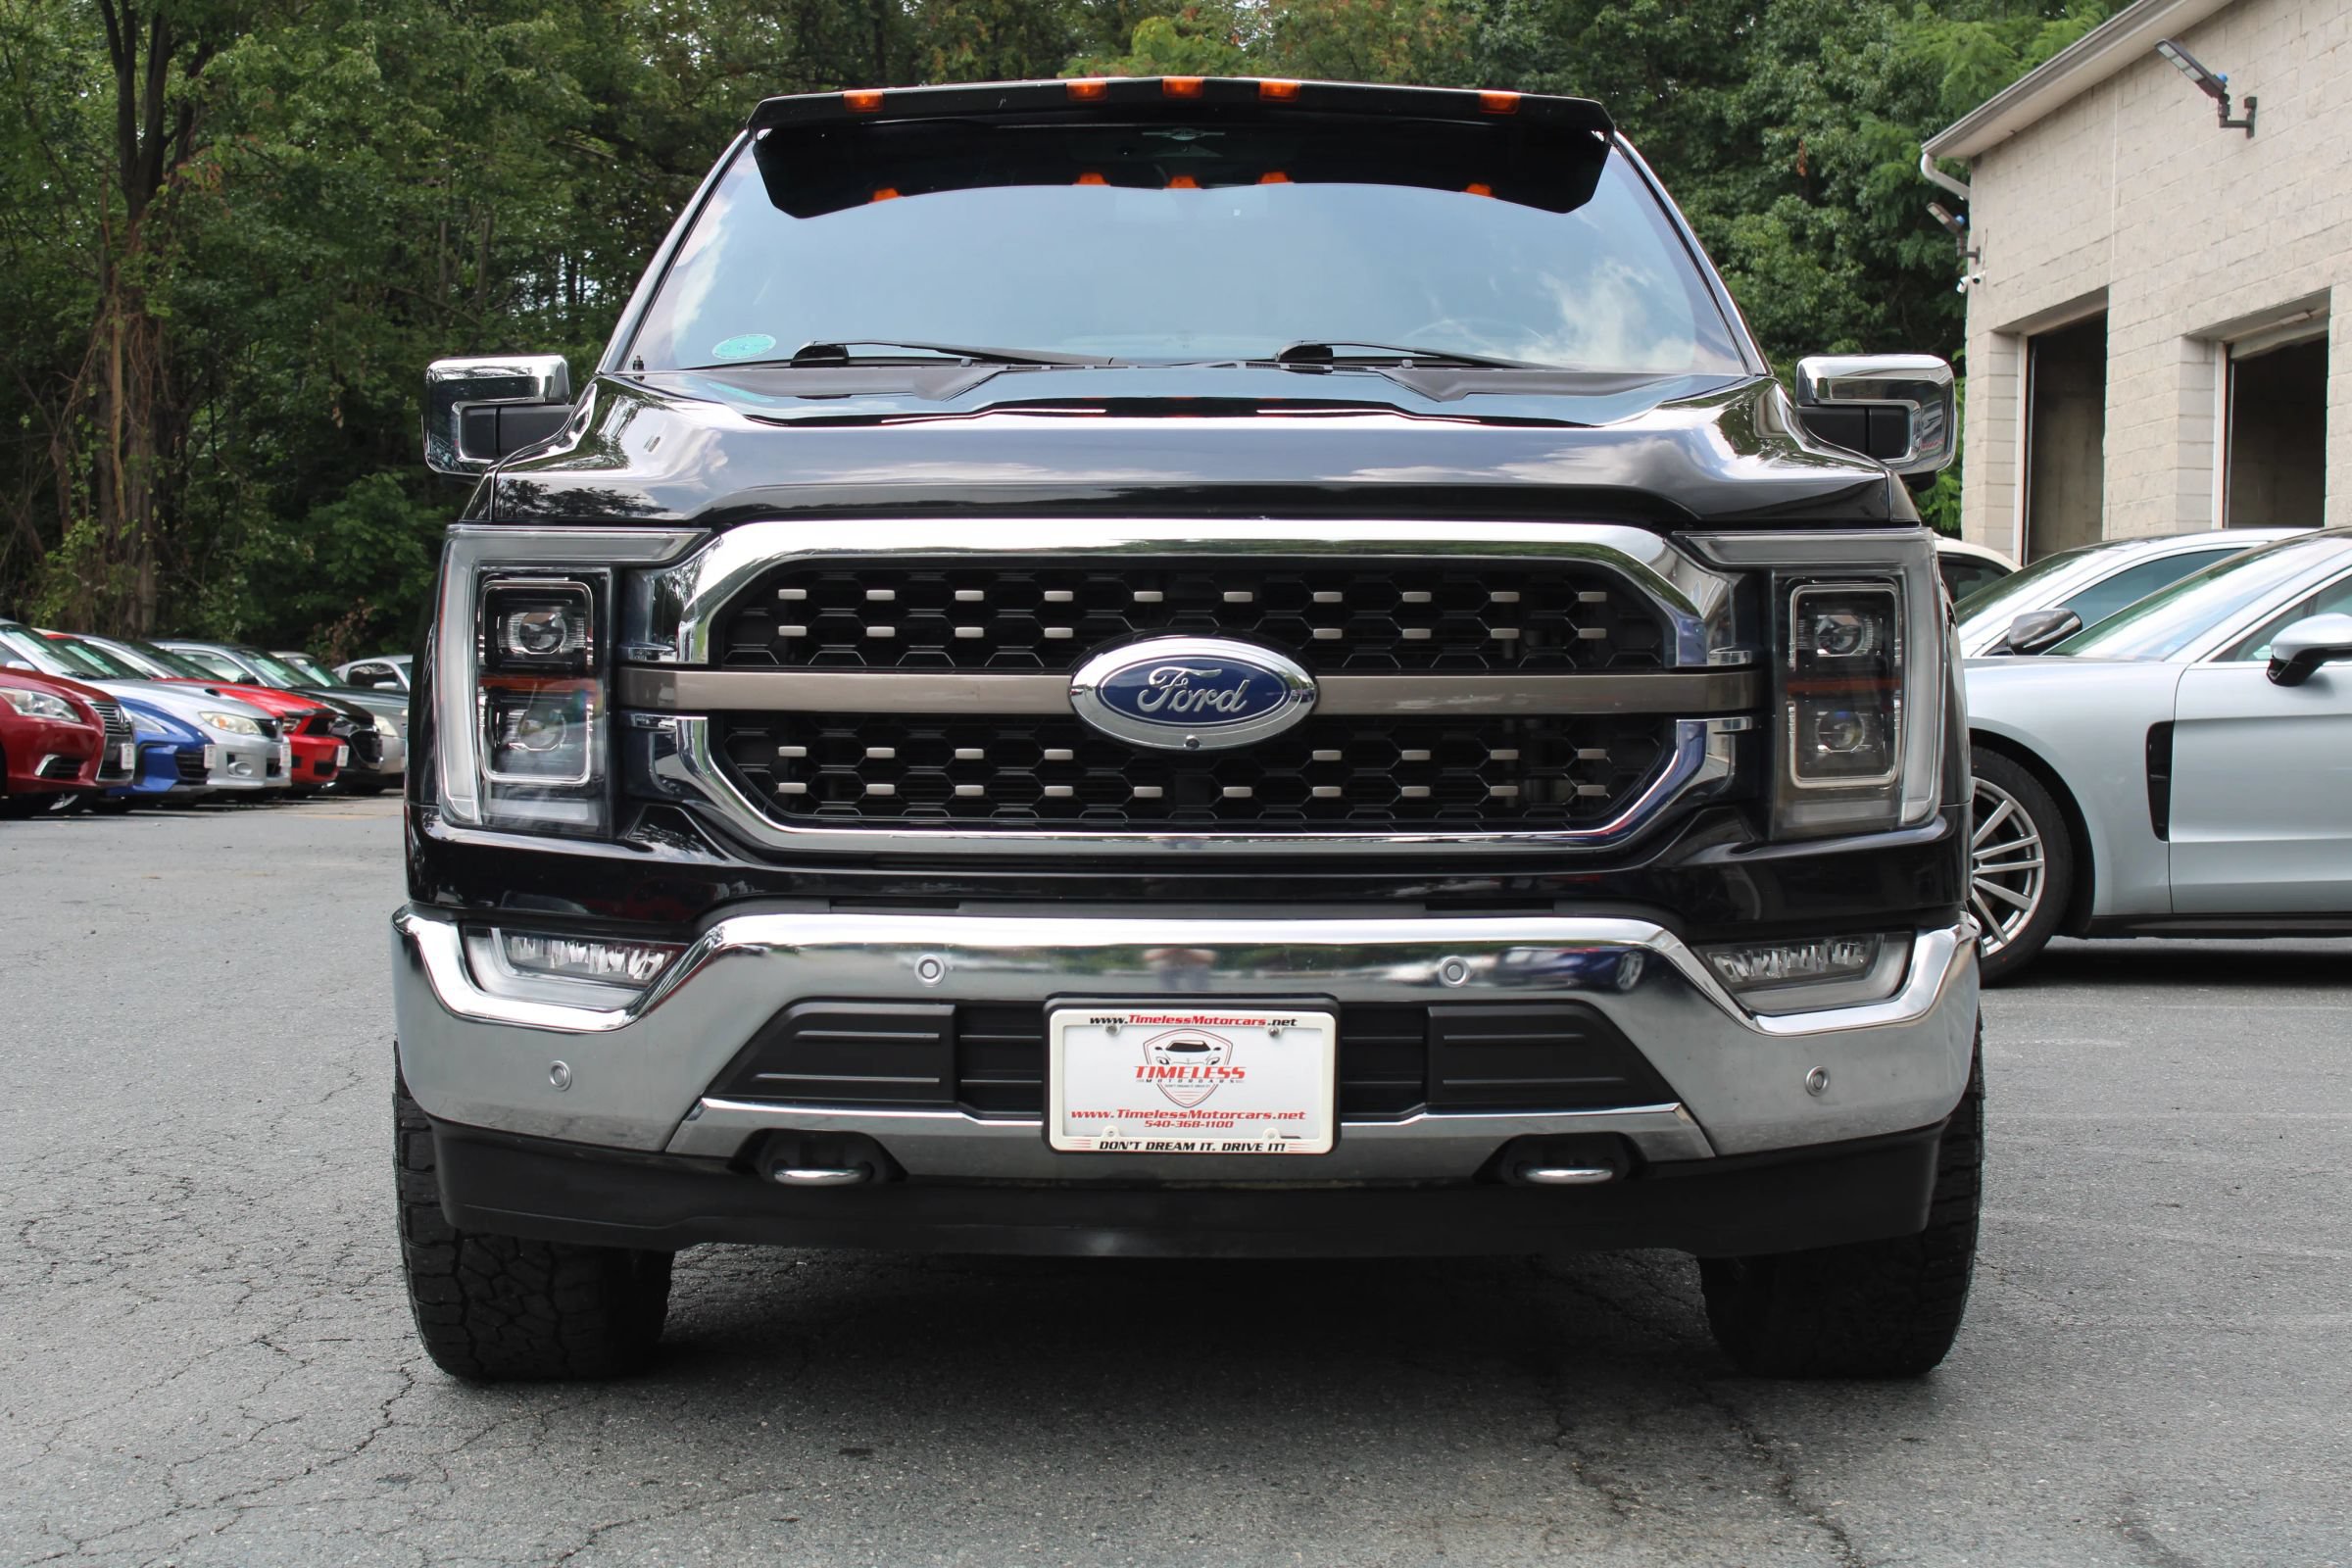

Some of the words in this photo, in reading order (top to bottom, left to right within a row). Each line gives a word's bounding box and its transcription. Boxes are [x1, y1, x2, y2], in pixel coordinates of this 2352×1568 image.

[1137, 666, 1250, 712] Ford
[1090, 1014, 1298, 1027] www.TimelessMotorcars.net
[1136, 1066, 1246, 1078] TIMELESS
[1071, 1109, 1307, 1120] www.TimelessMotorcars.net
[1100, 1141, 1142, 1151] DON'T
[1146, 1141, 1196, 1151] DREAM
[1200, 1142, 1216, 1152] IT.
[1222, 1143, 1263, 1152] DRIVE
[1267, 1143, 1287, 1152] IT!
